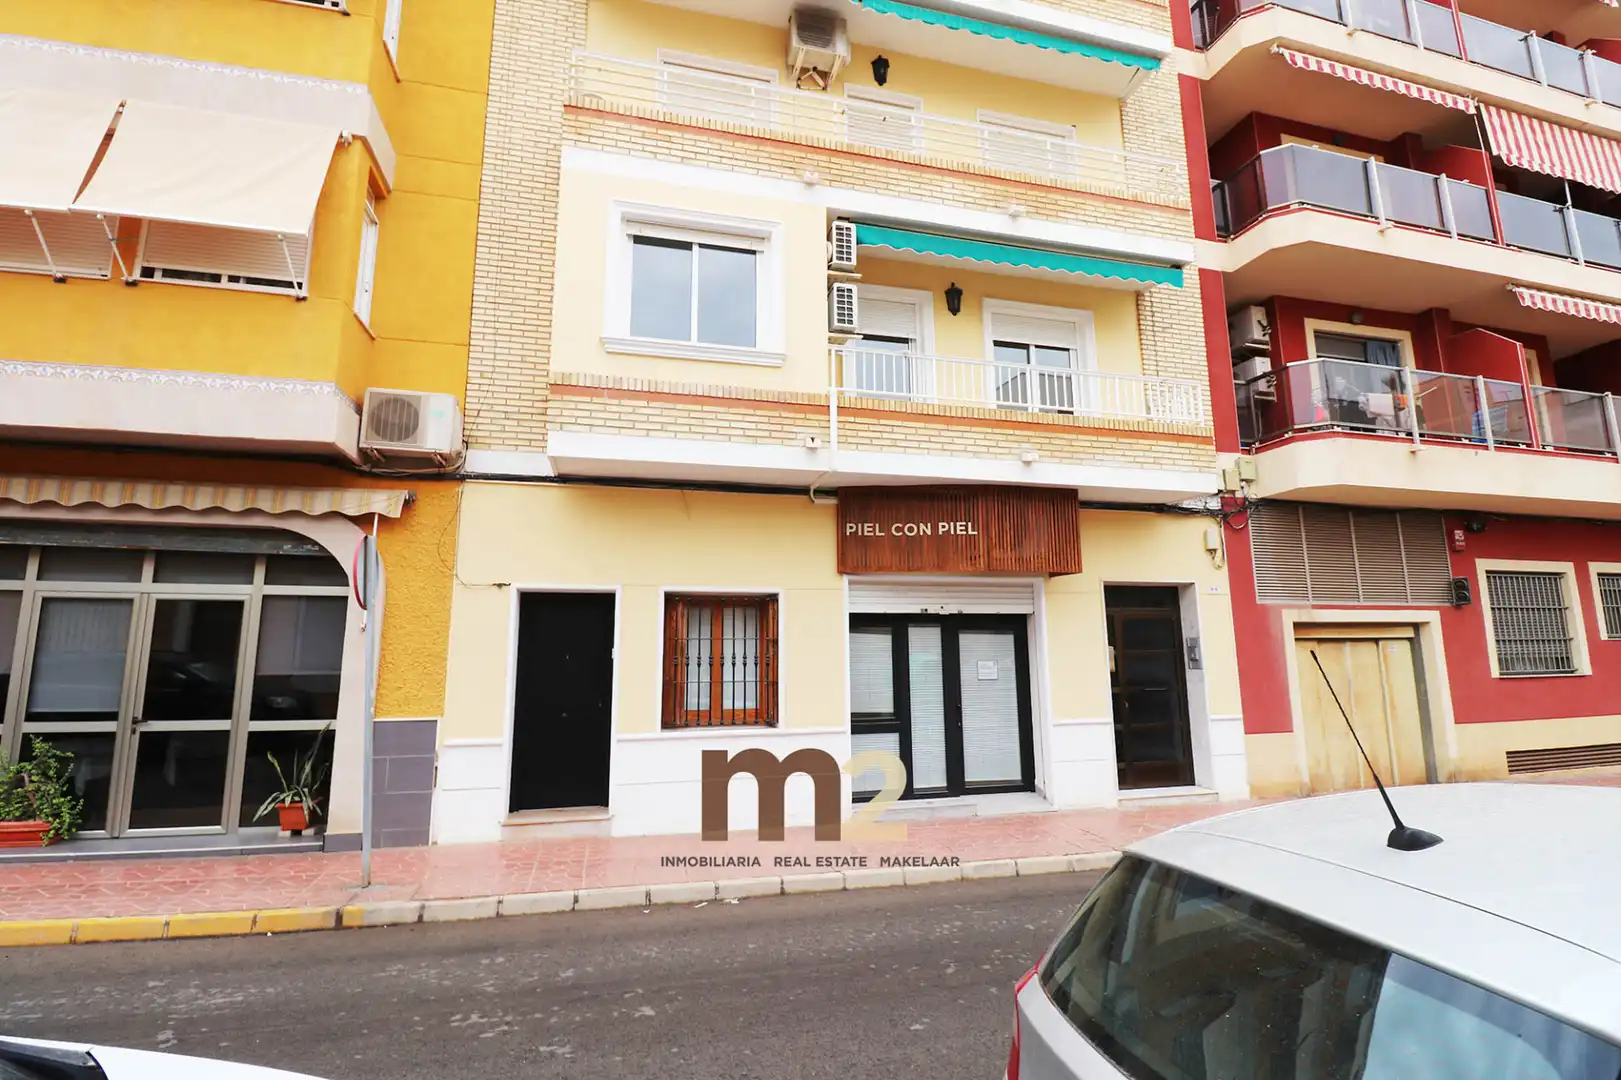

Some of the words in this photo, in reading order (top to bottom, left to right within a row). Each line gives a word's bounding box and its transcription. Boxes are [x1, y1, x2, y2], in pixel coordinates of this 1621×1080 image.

[845, 522, 885, 536] PIEL
[891, 522, 932, 536] CON
[938, 521, 978, 535] PIEL
